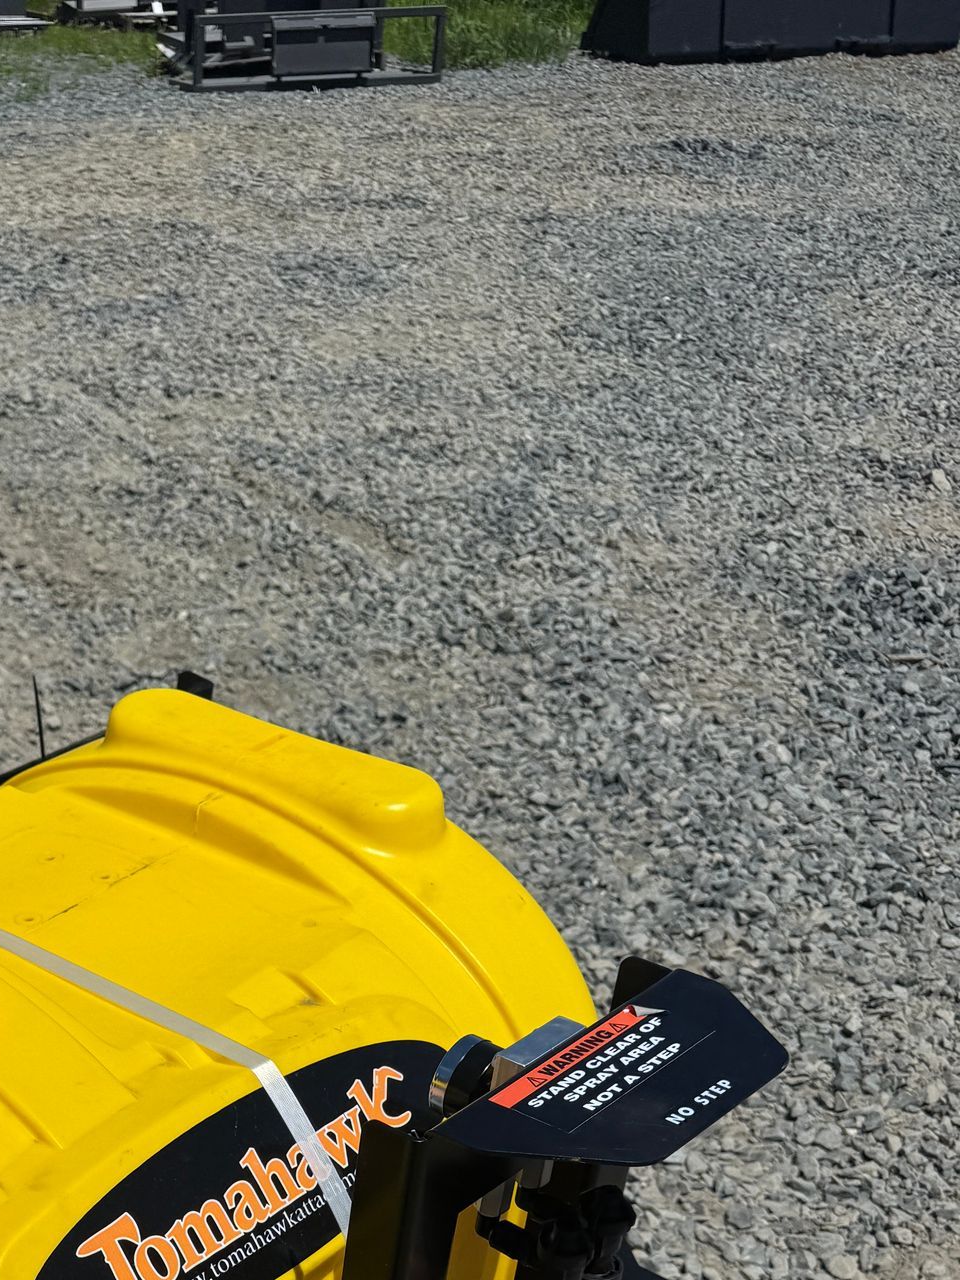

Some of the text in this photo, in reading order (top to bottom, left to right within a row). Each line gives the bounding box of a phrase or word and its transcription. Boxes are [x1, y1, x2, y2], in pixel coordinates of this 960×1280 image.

[527, 1016, 662, 1108] STAND CLEAR OF
[537, 1029, 615, 1077] WARNING
[563, 1035, 666, 1102] SPRAY AREA
[582, 1042, 682, 1111] NOT A STEP
[665, 1079, 733, 1125] NO STEP
